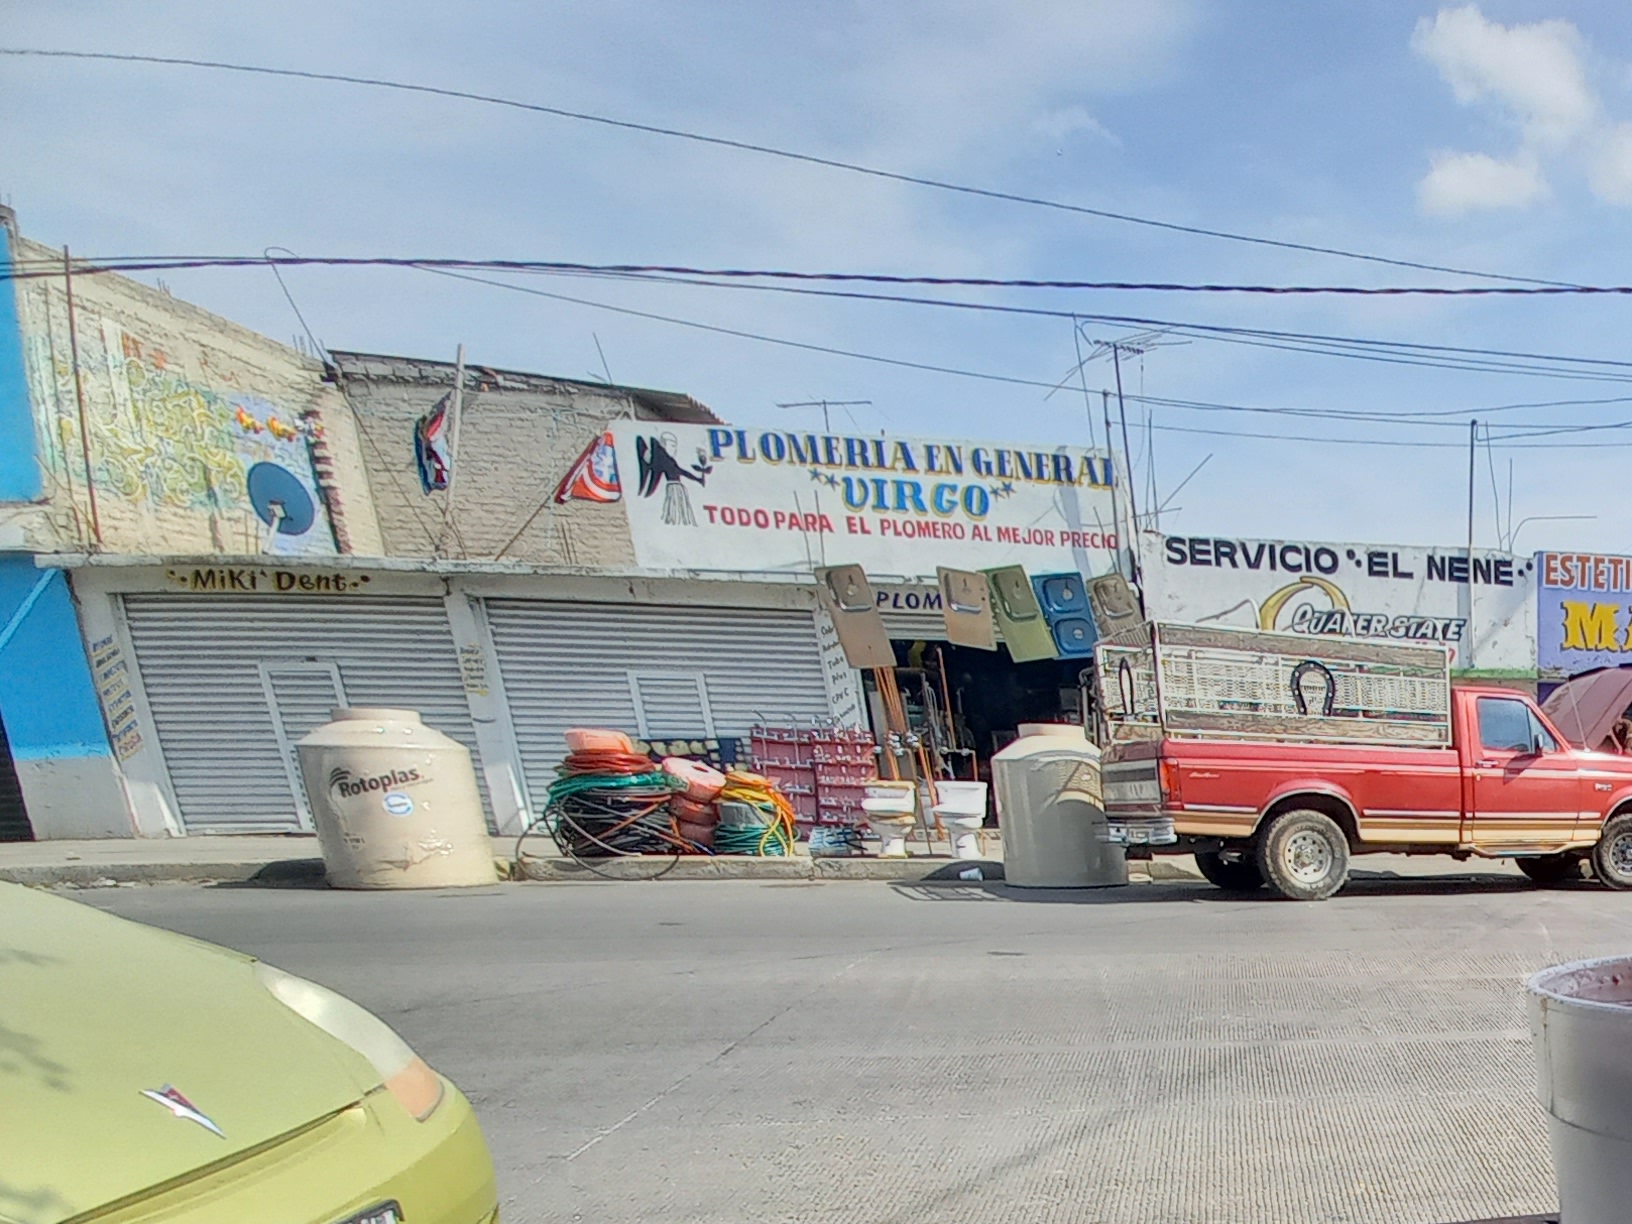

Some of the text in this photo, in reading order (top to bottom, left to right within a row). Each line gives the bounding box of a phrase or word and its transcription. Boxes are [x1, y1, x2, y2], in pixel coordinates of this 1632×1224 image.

[924, 444, 964, 476] EN
[972, 447, 1119, 491] GENERAL
[841, 476, 991, 521] VIRGO
[703, 504, 1119, 550] TODO PARA EL PLOMERO AL MEJOR PRECIO
[275, 570, 348, 591] Dent
[1167, 537, 1514, 587] SERVICIO EL NENE
[1389, 614, 1467, 642] STATE
[338, 768, 420, 798] Rotoplas
